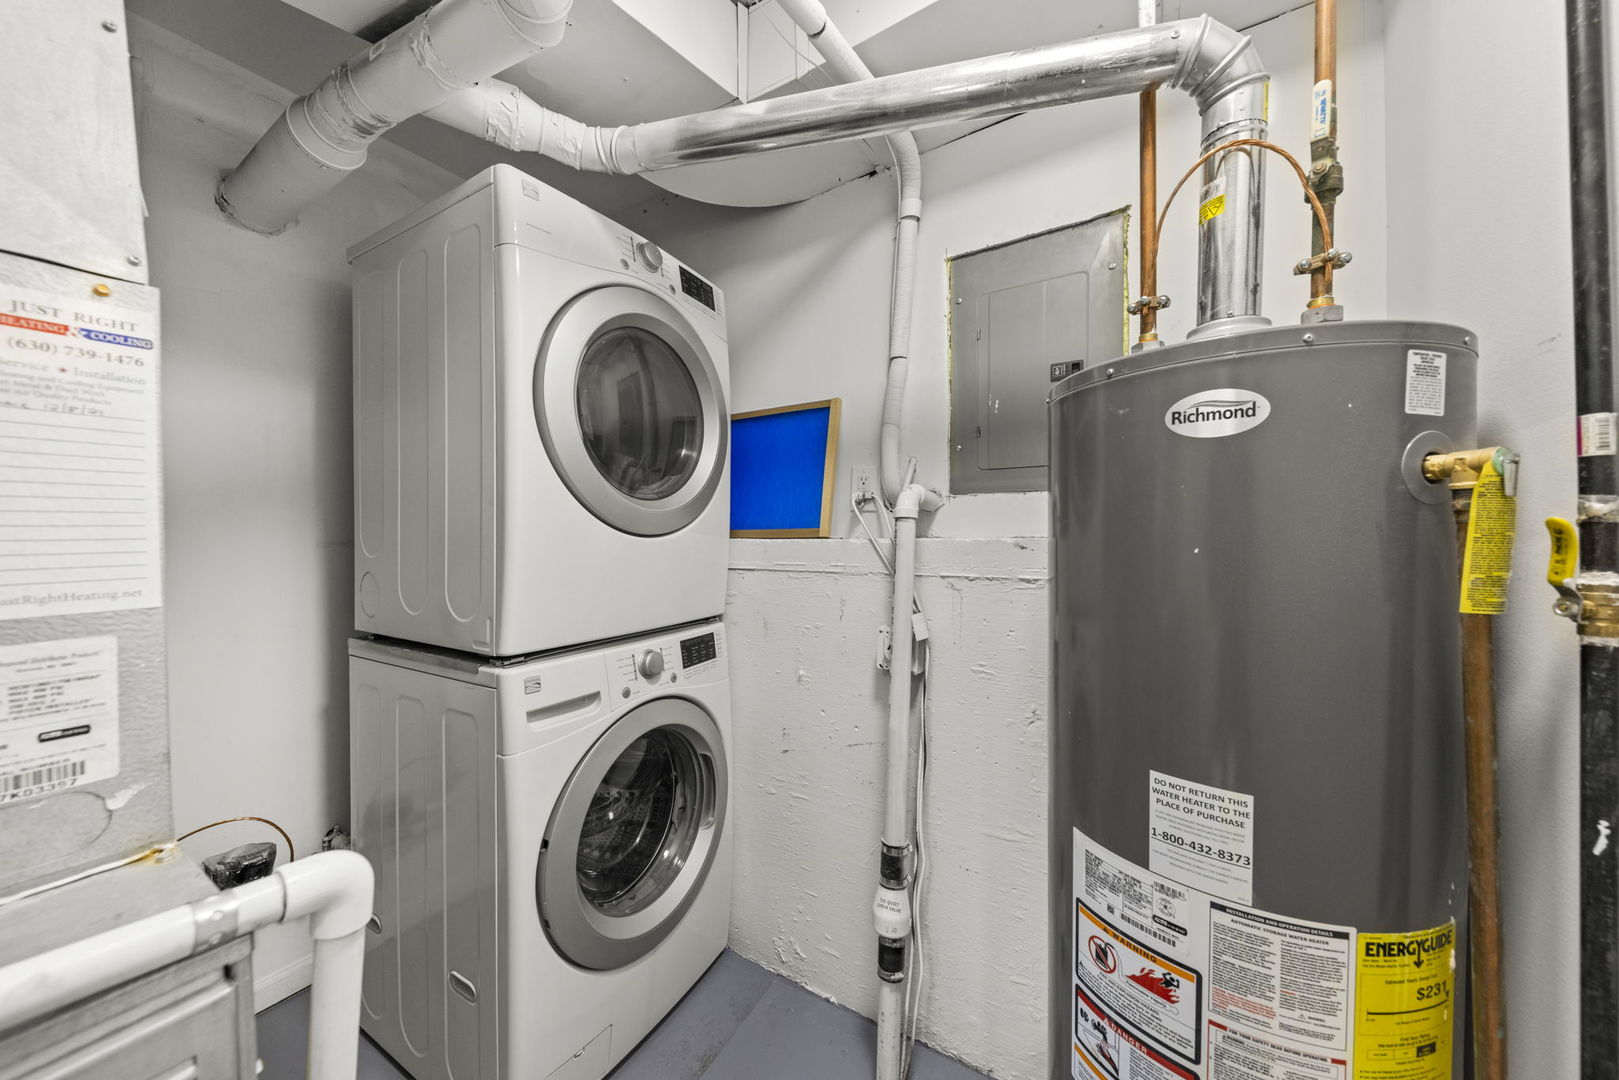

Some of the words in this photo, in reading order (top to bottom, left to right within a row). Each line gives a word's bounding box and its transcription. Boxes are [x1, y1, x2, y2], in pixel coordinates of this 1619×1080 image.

[8, 300, 62, 318] JUST
[74, 312, 139, 332] RIGHT
[8, 336, 58, 355] (630)
[64, 346, 145, 368] 739-1476
[90, 331, 152, 349] COOLING
[1171, 401, 1256, 425] Richmond
[1152, 786, 1180, 800] WATER
[1182, 796, 1216, 810] HEATER
[1218, 805, 1230, 814] TO
[1233, 810, 1250, 819] THE
[1154, 777, 1166, 786] DO
[1168, 782, 1186, 792] NOT
[1188, 788, 1224, 802] RETURN
[1227, 798, 1248, 808] THIS
[1156, 798, 1180, 811] PLACE
[1197, 810, 1245, 828] PURCHASE
[1151, 827, 1250, 866] 1-800-432-8373
[1226, 908, 1264, 924] INSTALLATION
[1278, 922, 1310, 934] OPERATION
[1311, 928, 1334, 937] DETAILS
[1231, 918, 1262, 932] AUTOMATIC
[1264, 926, 1287, 938] STORAGE
[1288, 934, 1307, 942] WATER
[1112, 931, 1156, 962] WARNING
[1366, 929, 1452, 957] ENERGYGUIDE
[1416, 980, 1447, 1000] $231
[1112, 1023, 1147, 1054] DANGER
[1252, 1036, 1270, 1046] SAFETY
